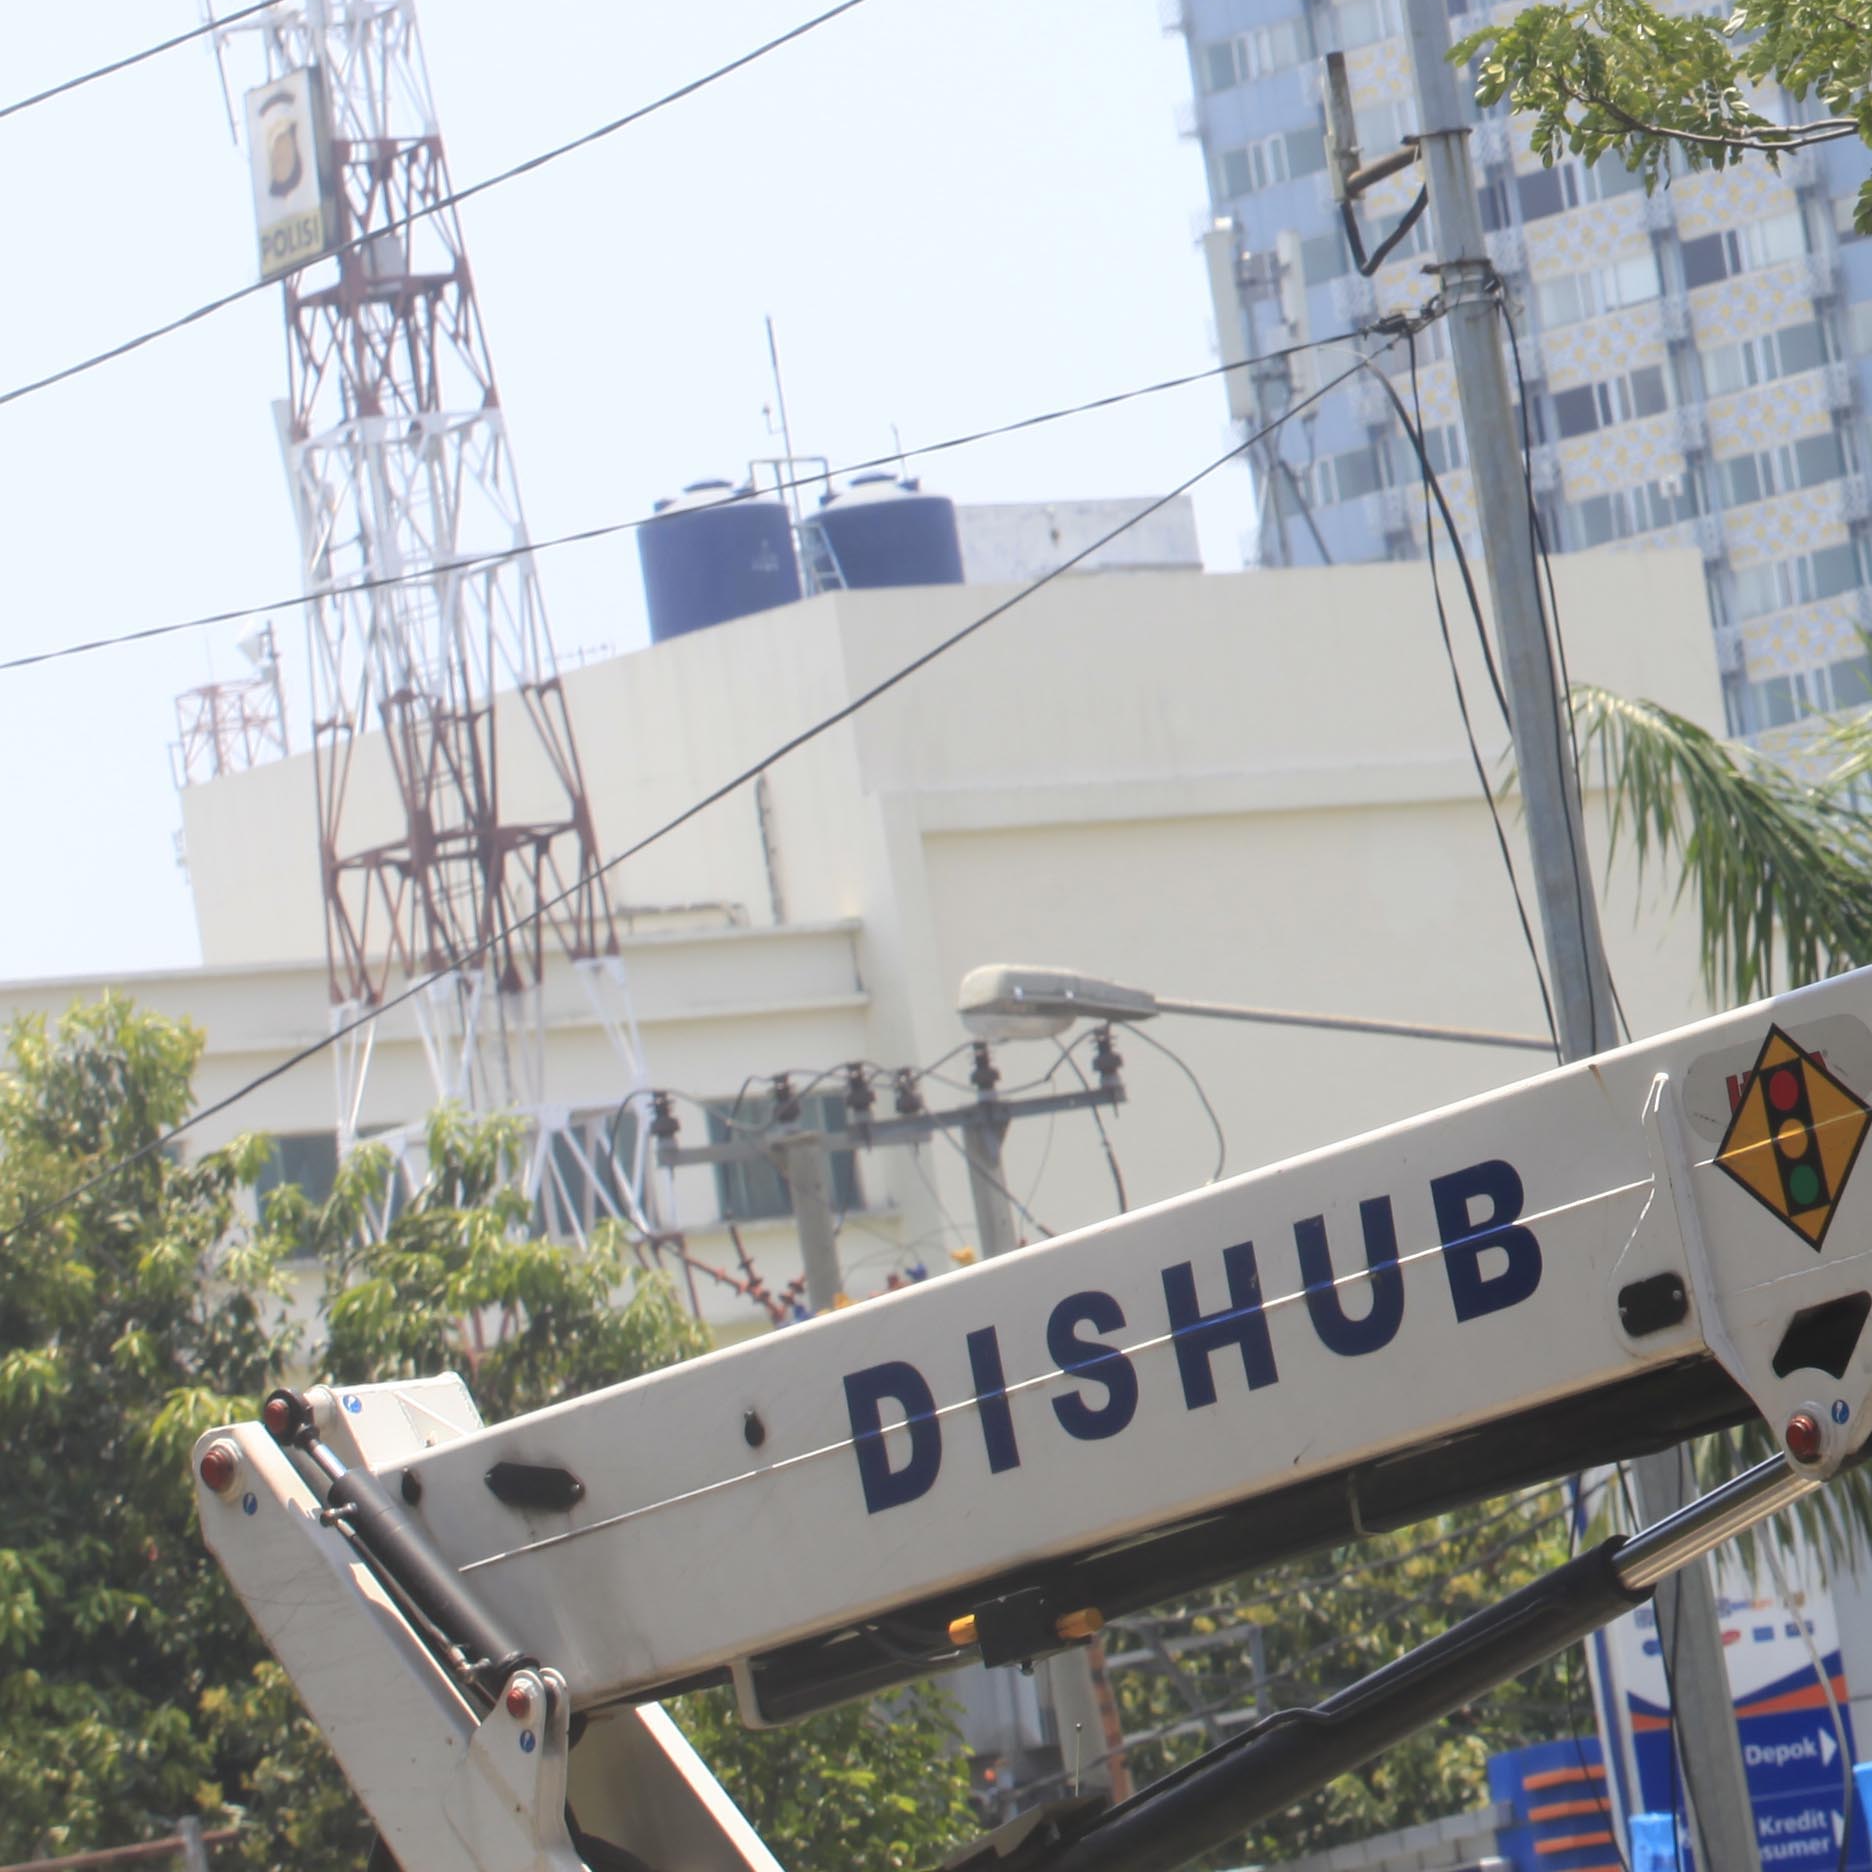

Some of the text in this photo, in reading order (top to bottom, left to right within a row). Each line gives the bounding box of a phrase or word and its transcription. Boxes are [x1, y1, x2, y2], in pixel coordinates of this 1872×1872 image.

[262, 218, 320, 262] POLISI
[842, 1159, 1544, 1516] DISHUB
[1745, 1738, 1817, 1766] Depok
[1759, 1810, 1828, 1836] Kredit
[1759, 1838, 1831, 1864] sumer
